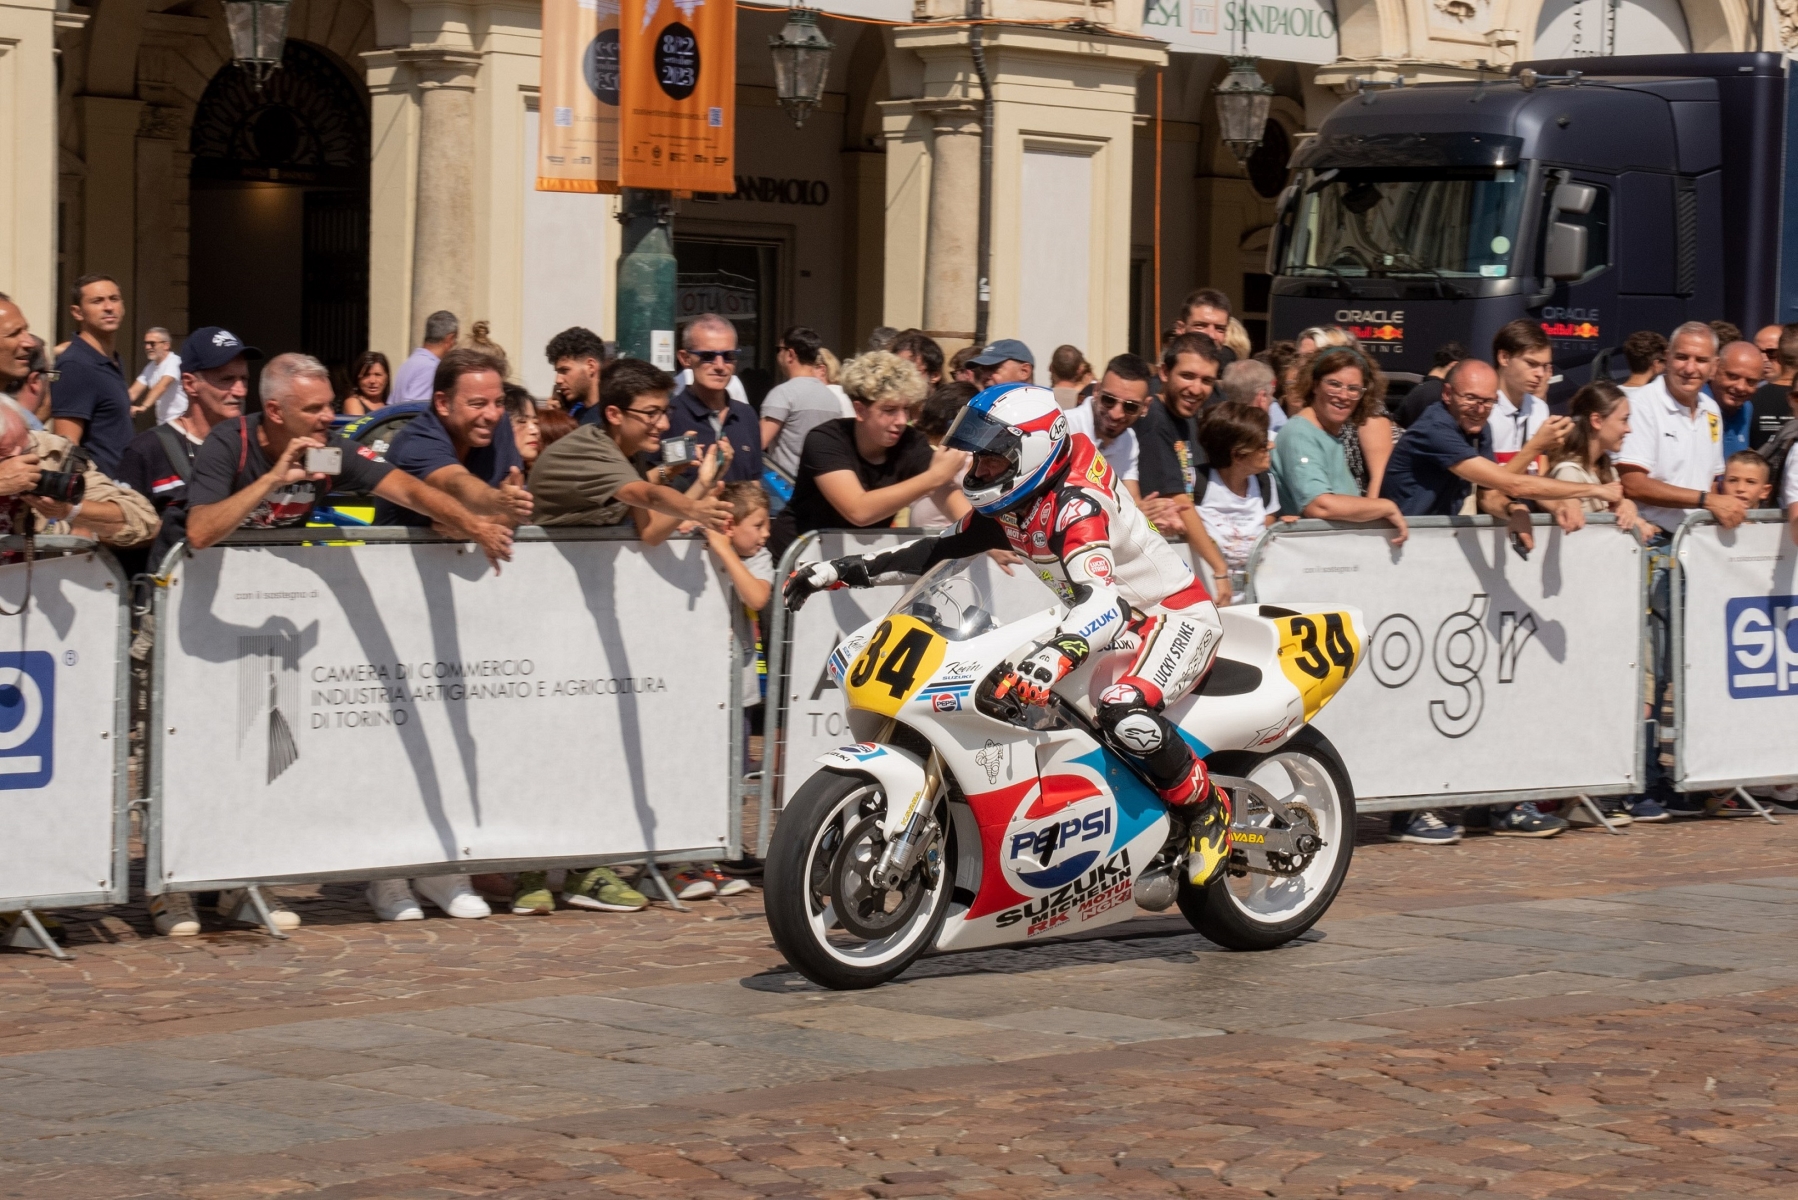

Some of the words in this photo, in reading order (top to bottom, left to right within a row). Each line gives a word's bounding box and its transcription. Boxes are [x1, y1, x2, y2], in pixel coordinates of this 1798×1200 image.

[1224, 1, 1337, 39] SANPAOLO
[1335, 309, 1405, 324] ORACLE
[1541, 306, 1600, 321] ORACLE
[235, 592, 254, 600] con
[264, 590, 305, 601] sostegno
[1079, 607, 1119, 638] UZUKI
[850, 620, 934, 700] 34
[1153, 652, 1177, 688] LUCKY
[1169, 621, 1195, 660] STRIKE
[1289, 612, 1355, 680] 34
[311, 662, 391, 683] CAMERA
[395, 663, 414, 680] DI
[418, 659, 535, 679] COMMERCIO
[945, 661, 984, 675] Kevin
[311, 686, 408, 706] INDUSTRIA
[411, 682, 532, 702] ARTIGIANATO
[537, 681, 547, 697] E
[551, 677, 668, 697] AGRICOLTURA
[311, 712, 330, 729] DI
[336, 708, 409, 728] TORINO
[1010, 806, 1111, 860] PEPSI
[995, 847, 1130, 928] SUZUKI
[1031, 866, 1132, 925] MICHELIN
[1077, 878, 1132, 913] MOTUL
[1083, 891, 1127, 921] NGK
[1027, 911, 1070, 936] RK
